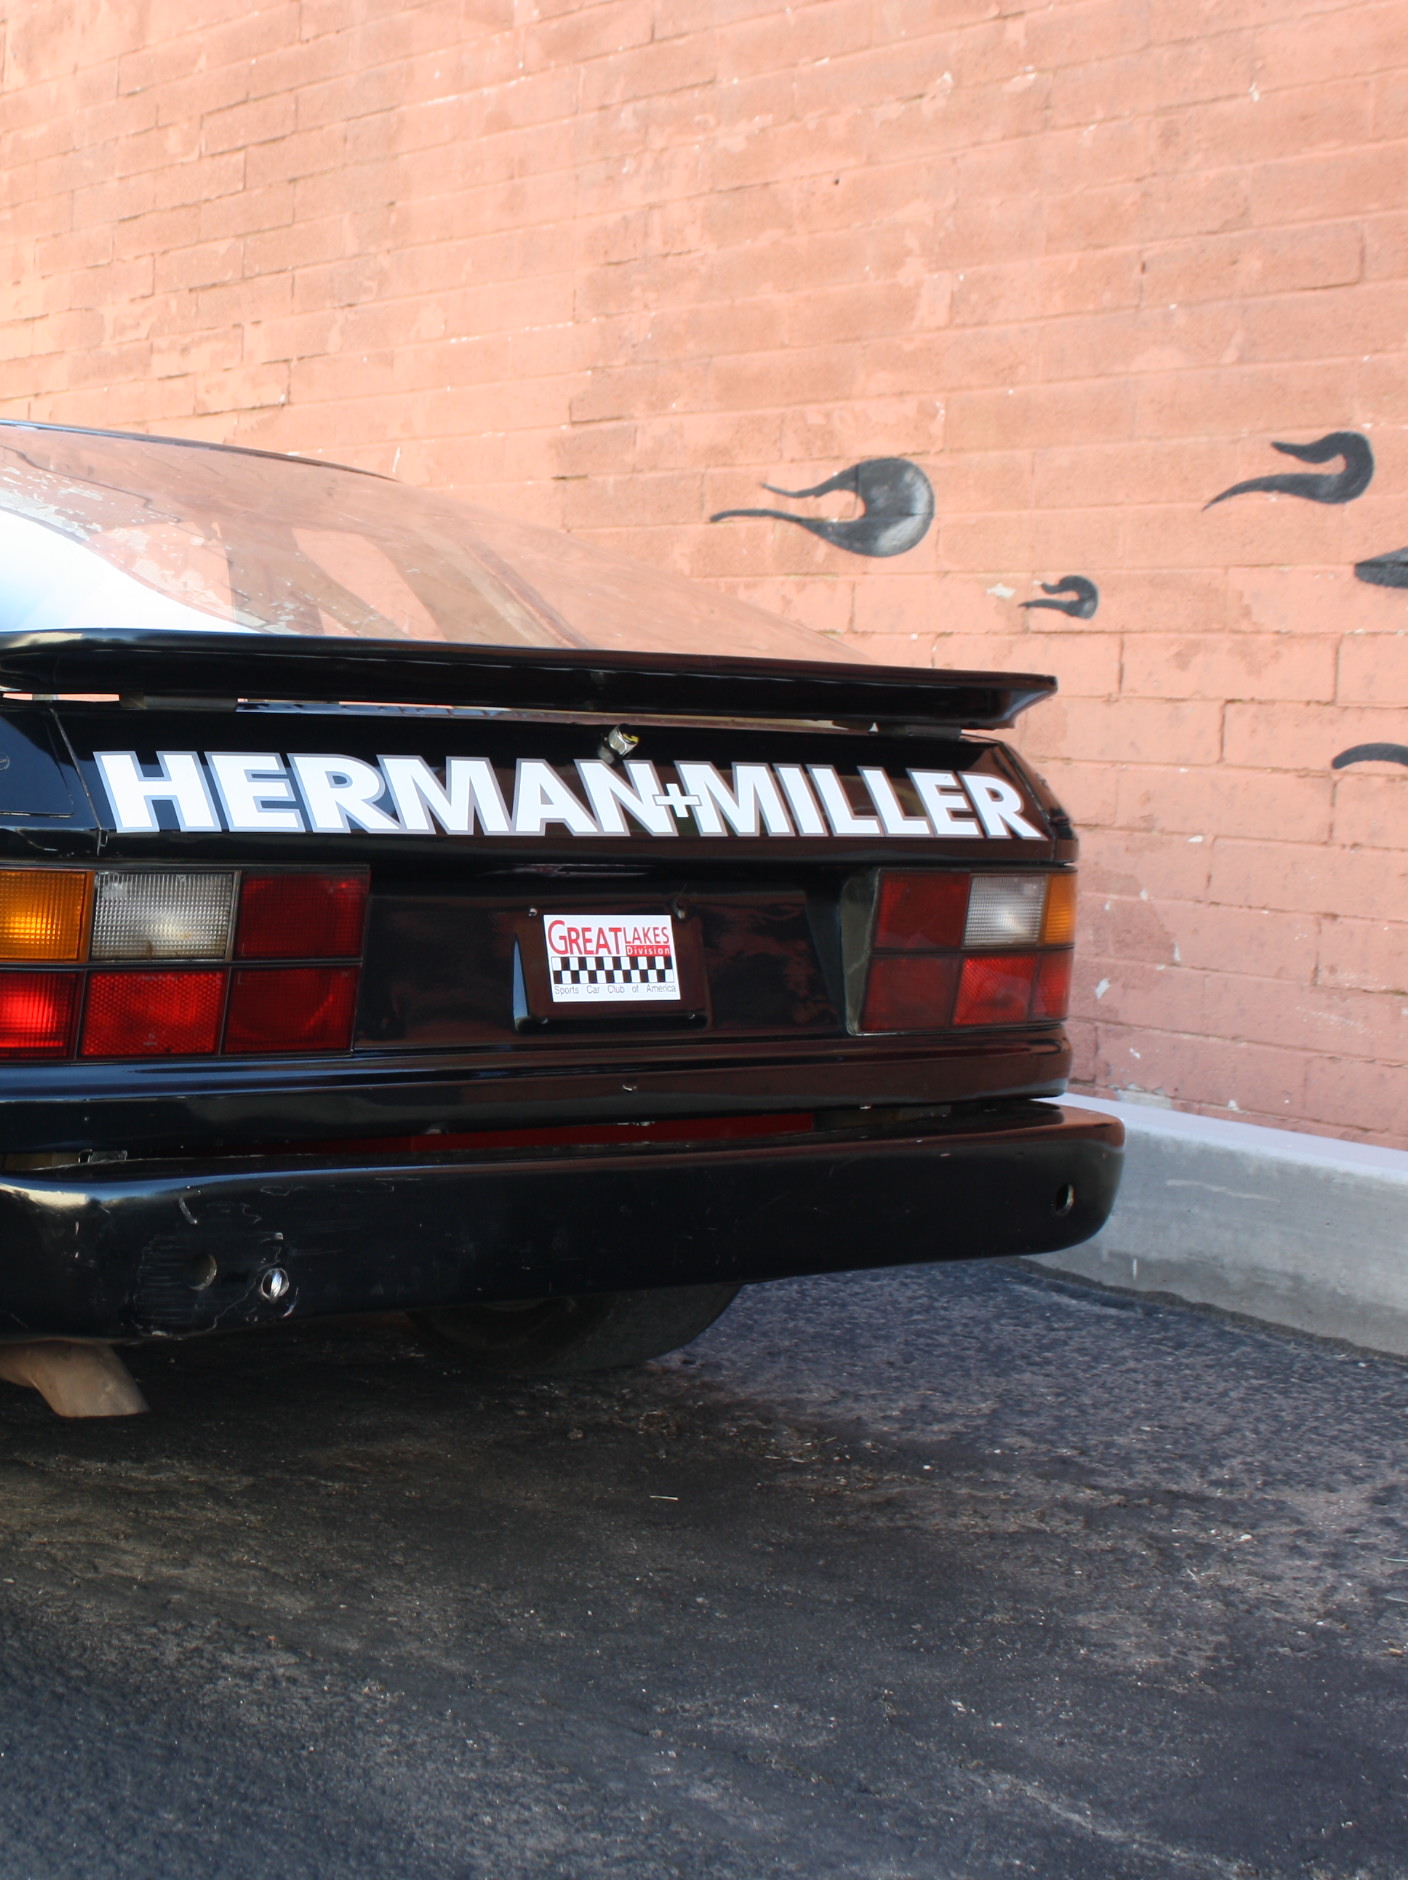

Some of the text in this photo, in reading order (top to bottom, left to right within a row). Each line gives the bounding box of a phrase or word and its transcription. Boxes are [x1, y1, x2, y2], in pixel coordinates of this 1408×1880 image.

[547, 919, 670, 956] GREAT LAKES
[626, 946, 671, 956] Division
[554, 983, 677, 996] Sports Car Club of America
